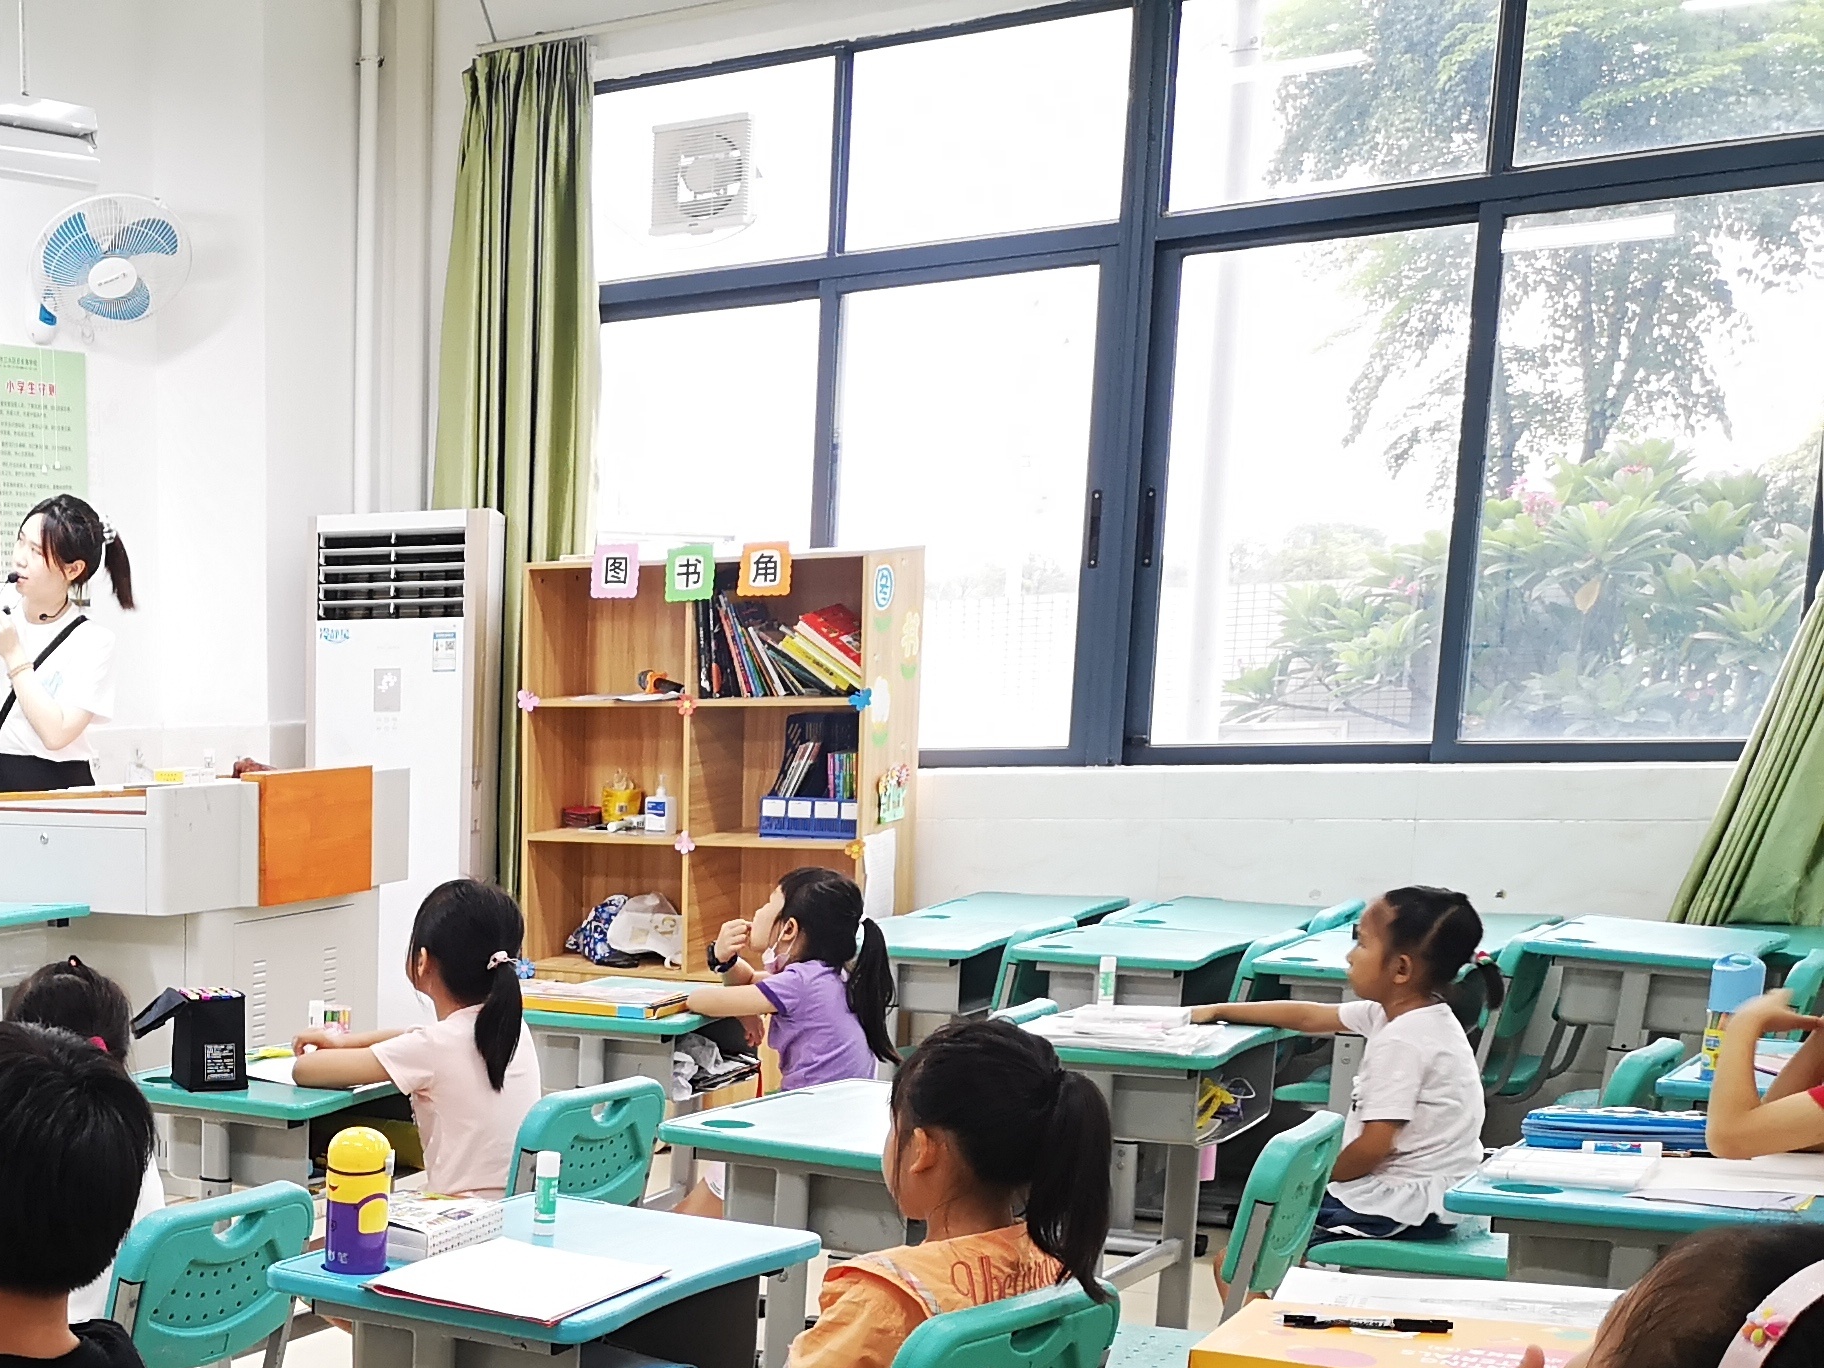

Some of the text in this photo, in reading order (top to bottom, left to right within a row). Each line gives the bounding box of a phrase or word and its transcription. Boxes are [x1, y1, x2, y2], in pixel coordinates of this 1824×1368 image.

[604, 552, 778, 588] 图 书 角
